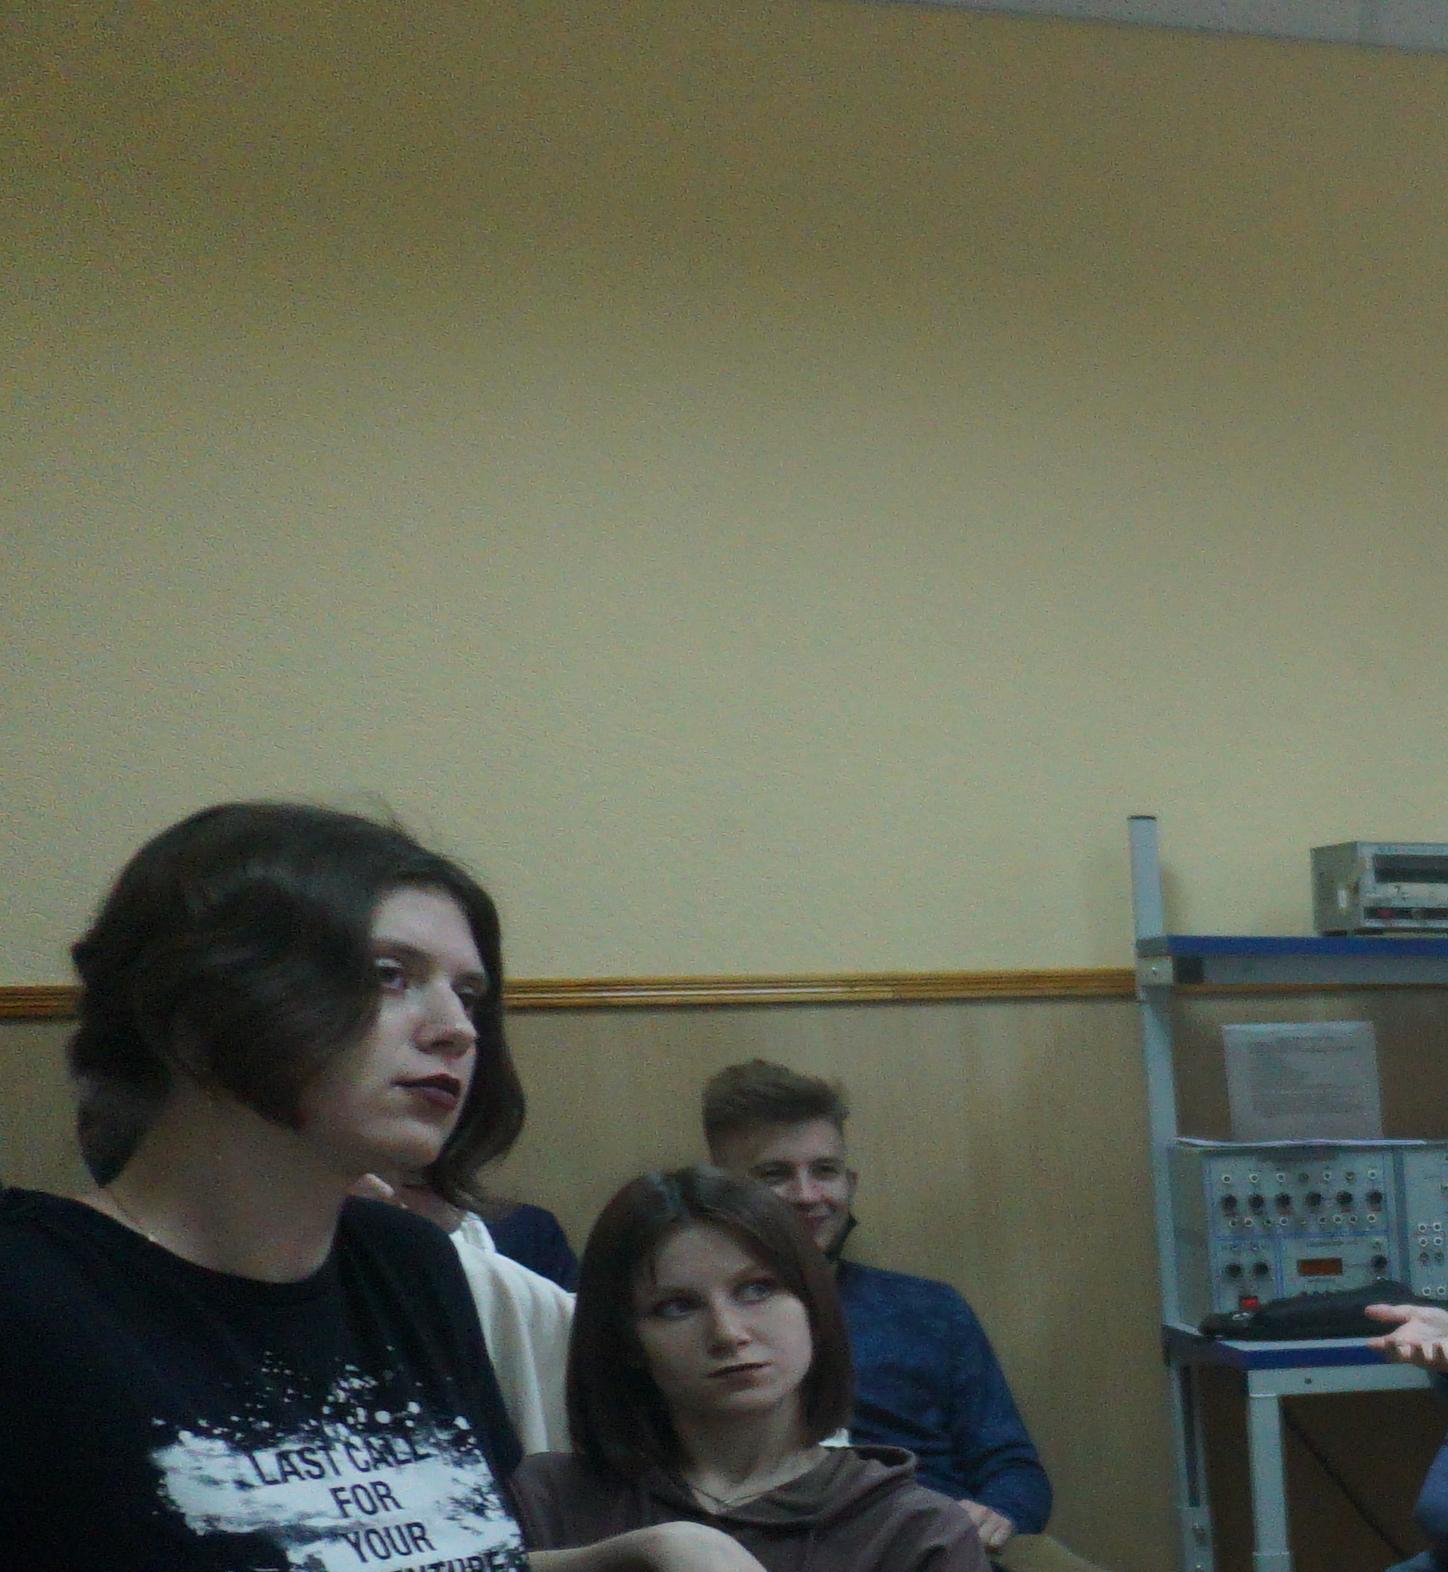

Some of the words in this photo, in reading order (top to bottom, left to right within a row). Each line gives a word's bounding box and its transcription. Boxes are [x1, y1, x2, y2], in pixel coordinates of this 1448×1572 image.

[249, 1445, 342, 1486] LAST
[343, 1436, 433, 1474] CALL
[329, 1480, 403, 1519] FOR
[341, 1521, 436, 1564] YOUR
